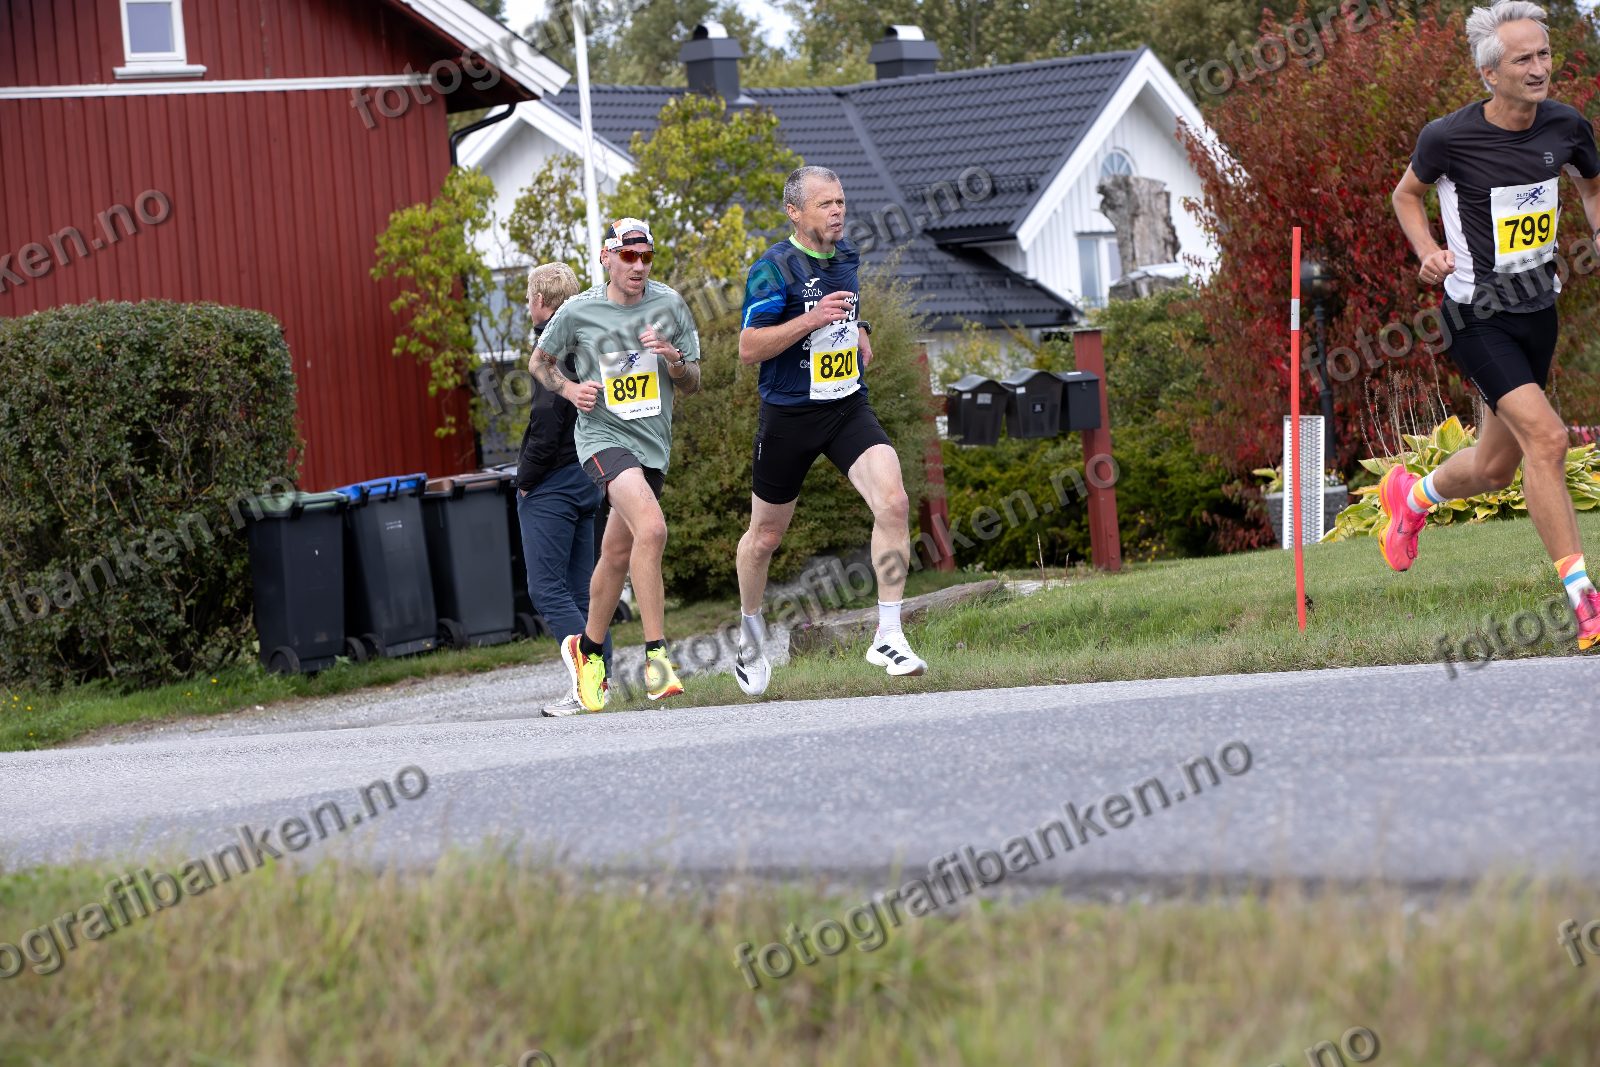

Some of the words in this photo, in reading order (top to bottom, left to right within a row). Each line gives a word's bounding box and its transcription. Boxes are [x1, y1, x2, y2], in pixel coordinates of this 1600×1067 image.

[1504, 213, 1551, 249] 799
[802, 288, 823, 298] 2026
[820, 350, 853, 379] 820
[612, 374, 650, 402] 897
